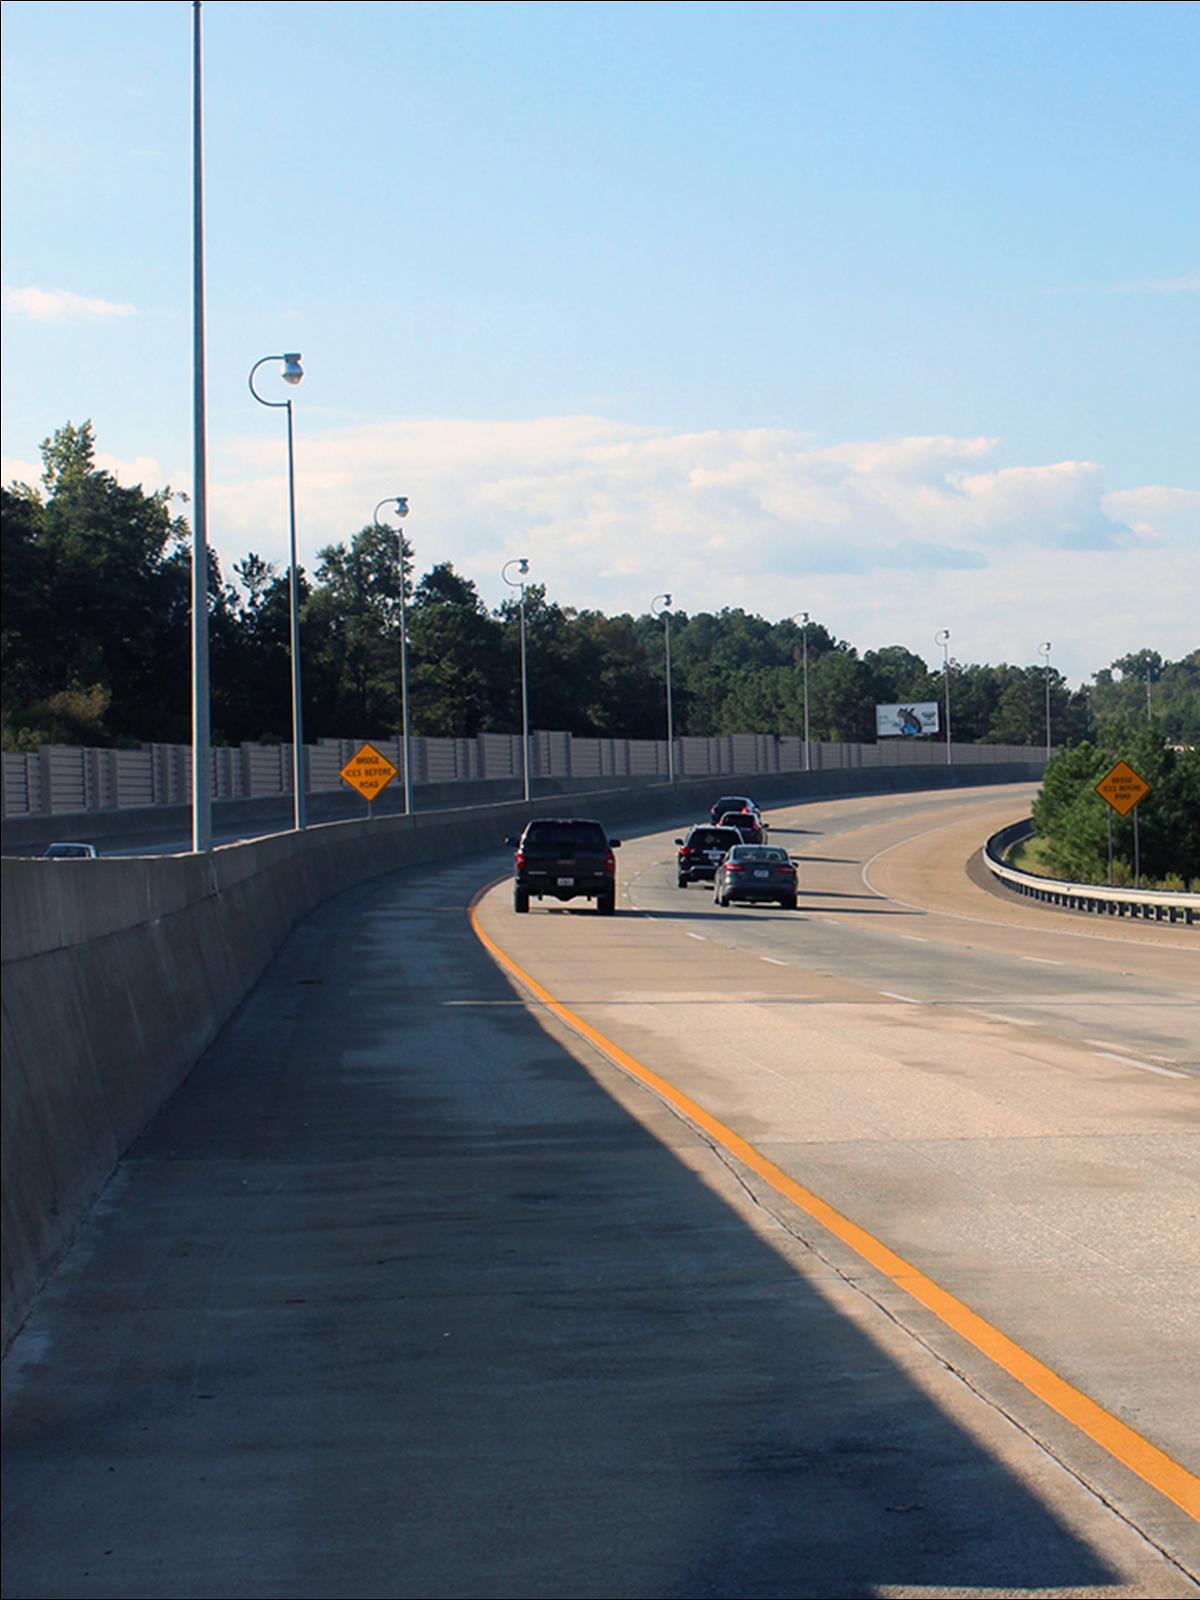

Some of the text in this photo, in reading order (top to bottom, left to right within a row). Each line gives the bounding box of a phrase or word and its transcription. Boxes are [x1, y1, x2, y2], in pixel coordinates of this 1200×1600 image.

[356, 756, 379, 764] BRIDGE
[345, 768, 391, 777] ICES BEFORE
[360, 780, 379, 788] ROAD
